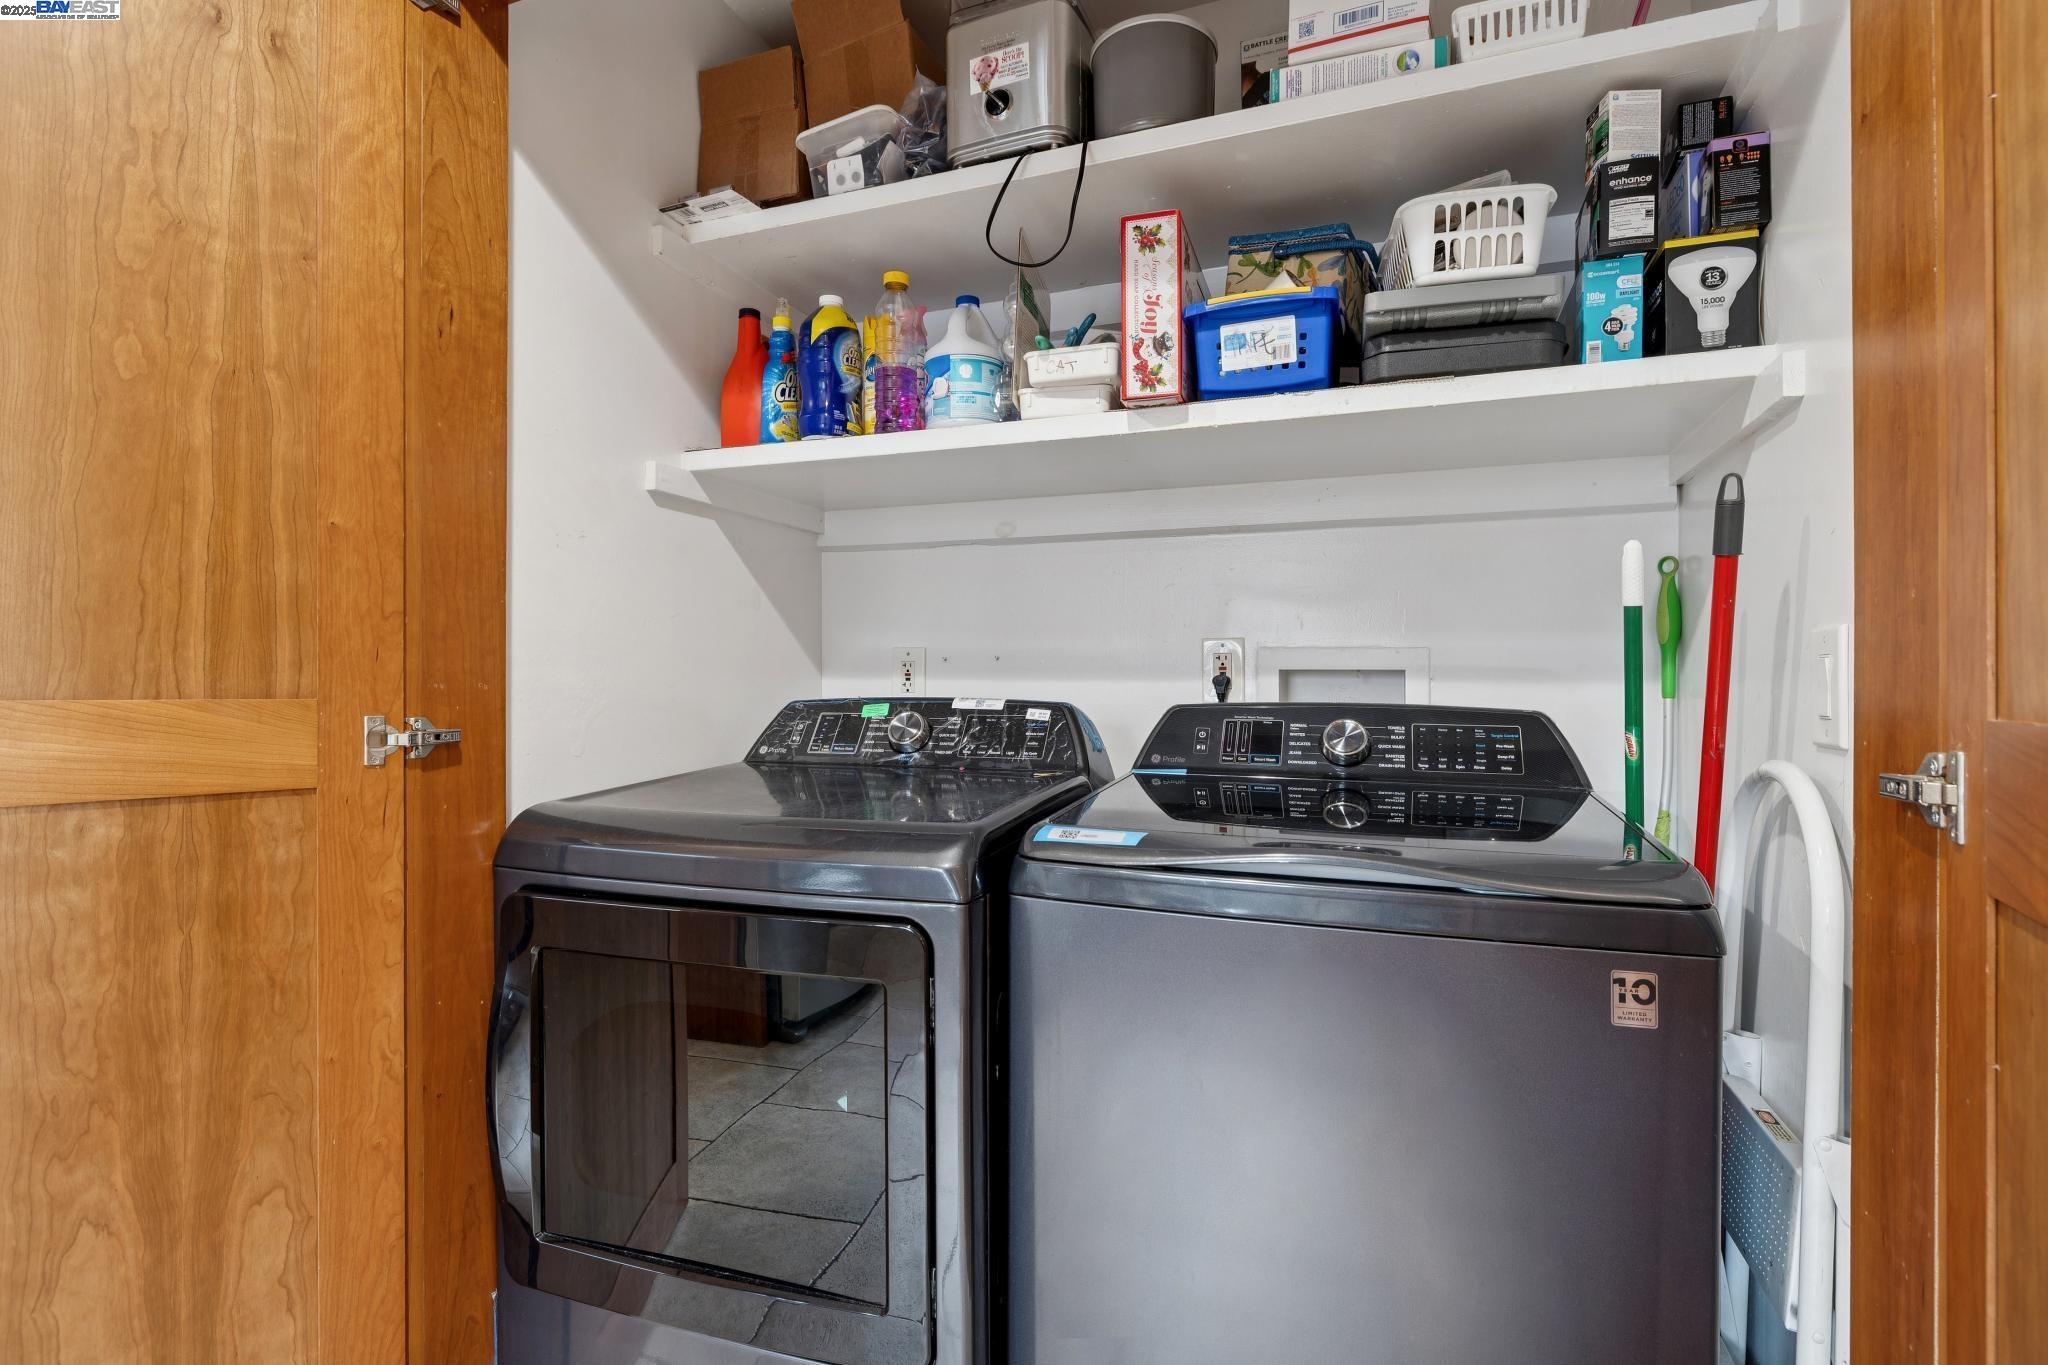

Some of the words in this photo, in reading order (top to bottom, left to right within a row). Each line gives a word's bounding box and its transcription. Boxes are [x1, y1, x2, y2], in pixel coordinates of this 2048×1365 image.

[1250, 38, 1273, 48] BATTLE
[1609, 175, 1652, 187] enhance
[1705, 272, 1720, 282] 13
[1700, 296, 1726, 305] 15,000
[1046, 359, 1078, 375] CAT
[1162, 755, 1186, 763] Profile
[1613, 977, 1657, 1005] 10
